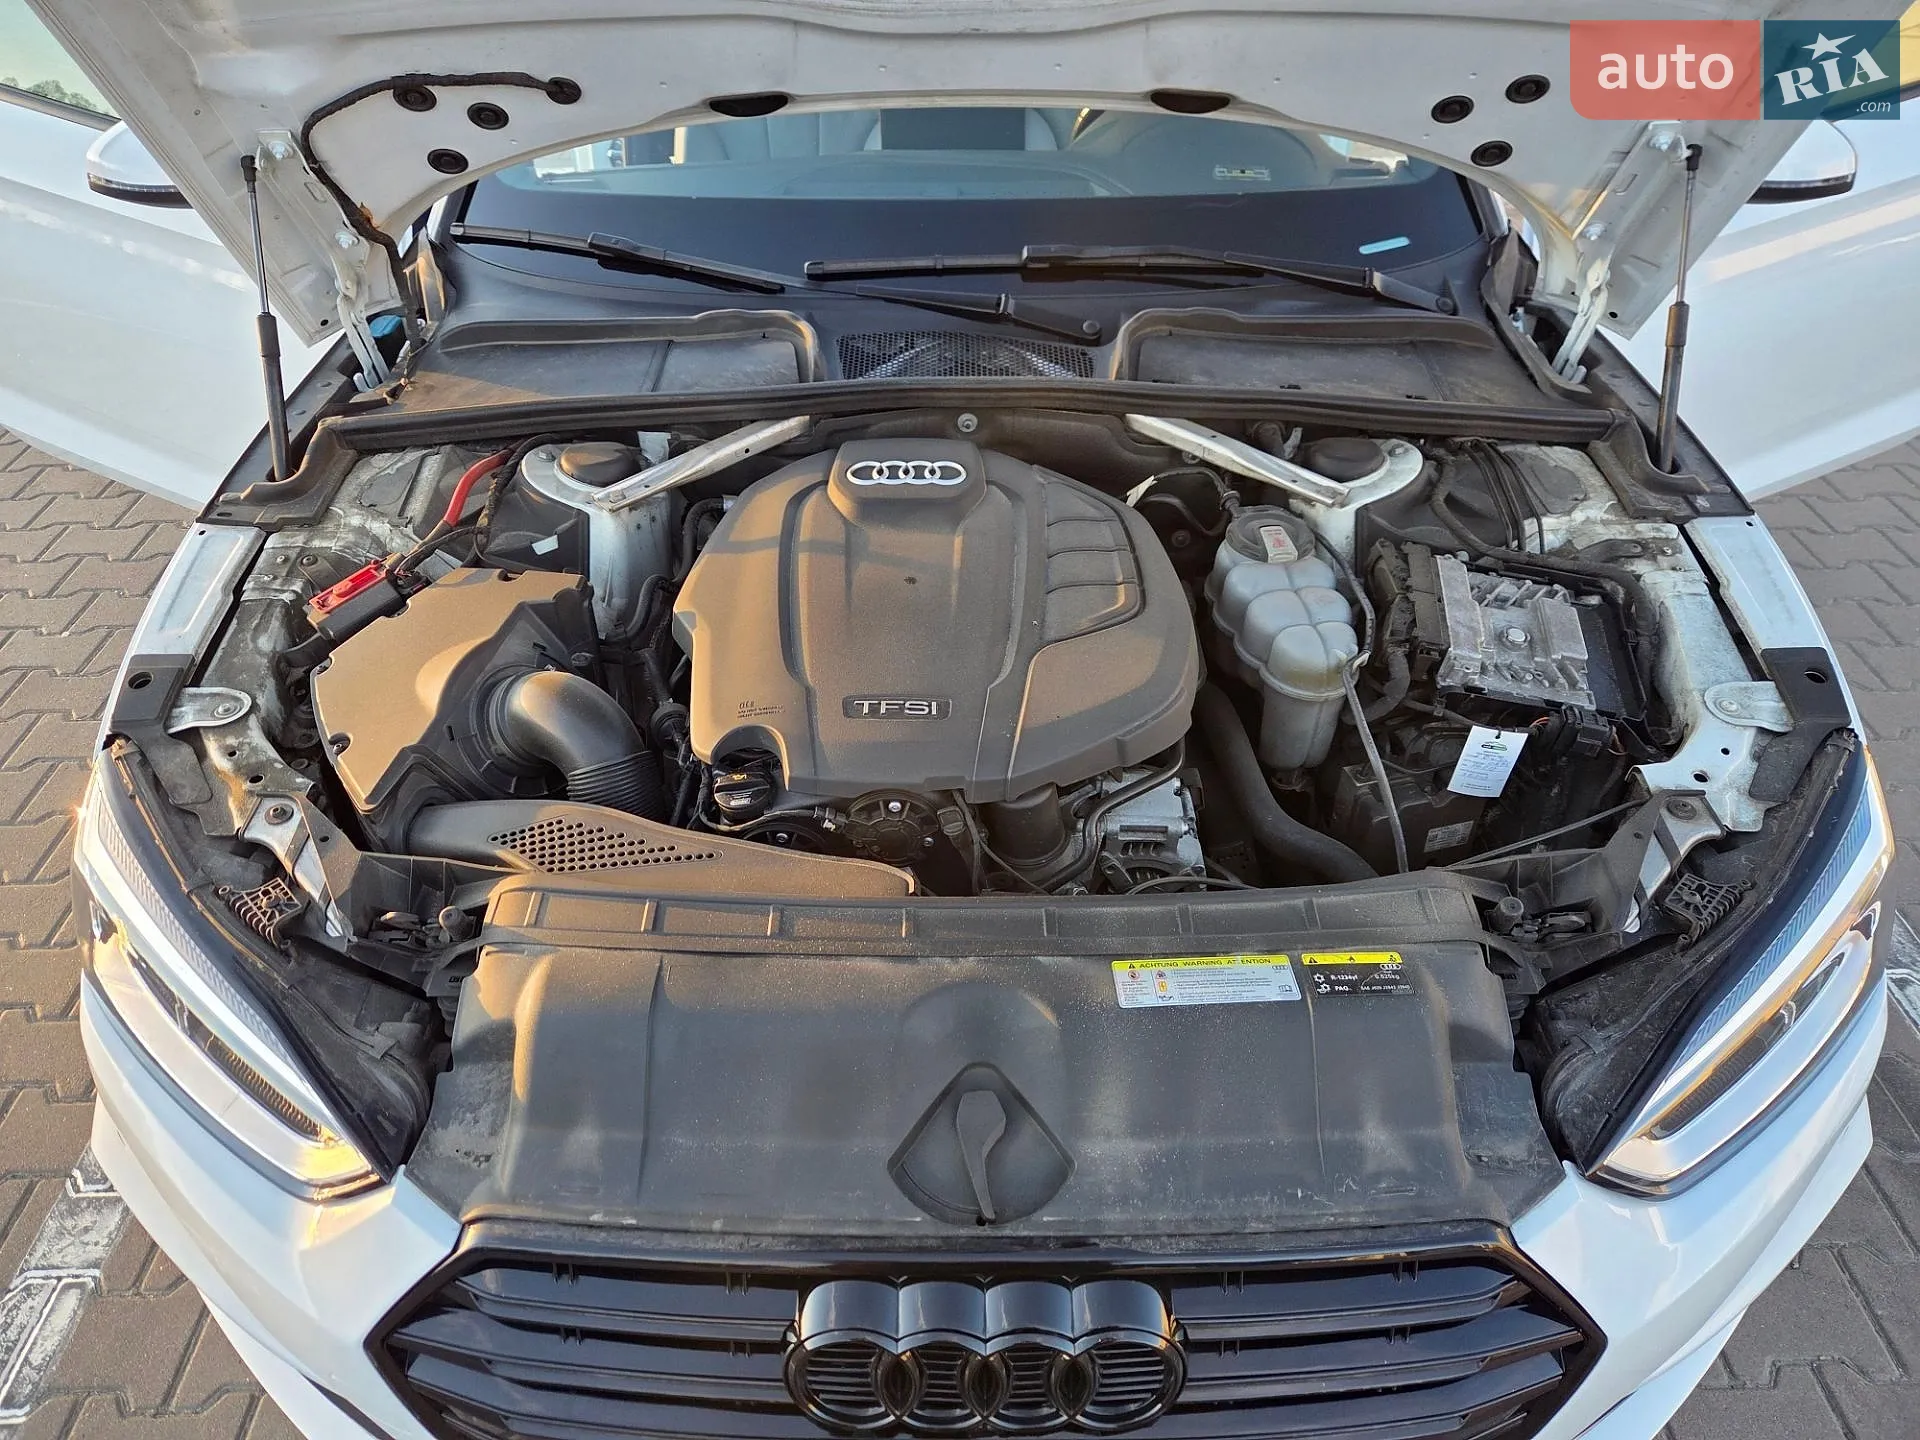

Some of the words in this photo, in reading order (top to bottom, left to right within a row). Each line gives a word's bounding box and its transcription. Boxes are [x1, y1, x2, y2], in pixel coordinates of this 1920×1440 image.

[853, 700, 937, 715] TFSI
[1139, 961, 1179, 969] ACHTUNG
[1182, 959, 1223, 967] WARNING
